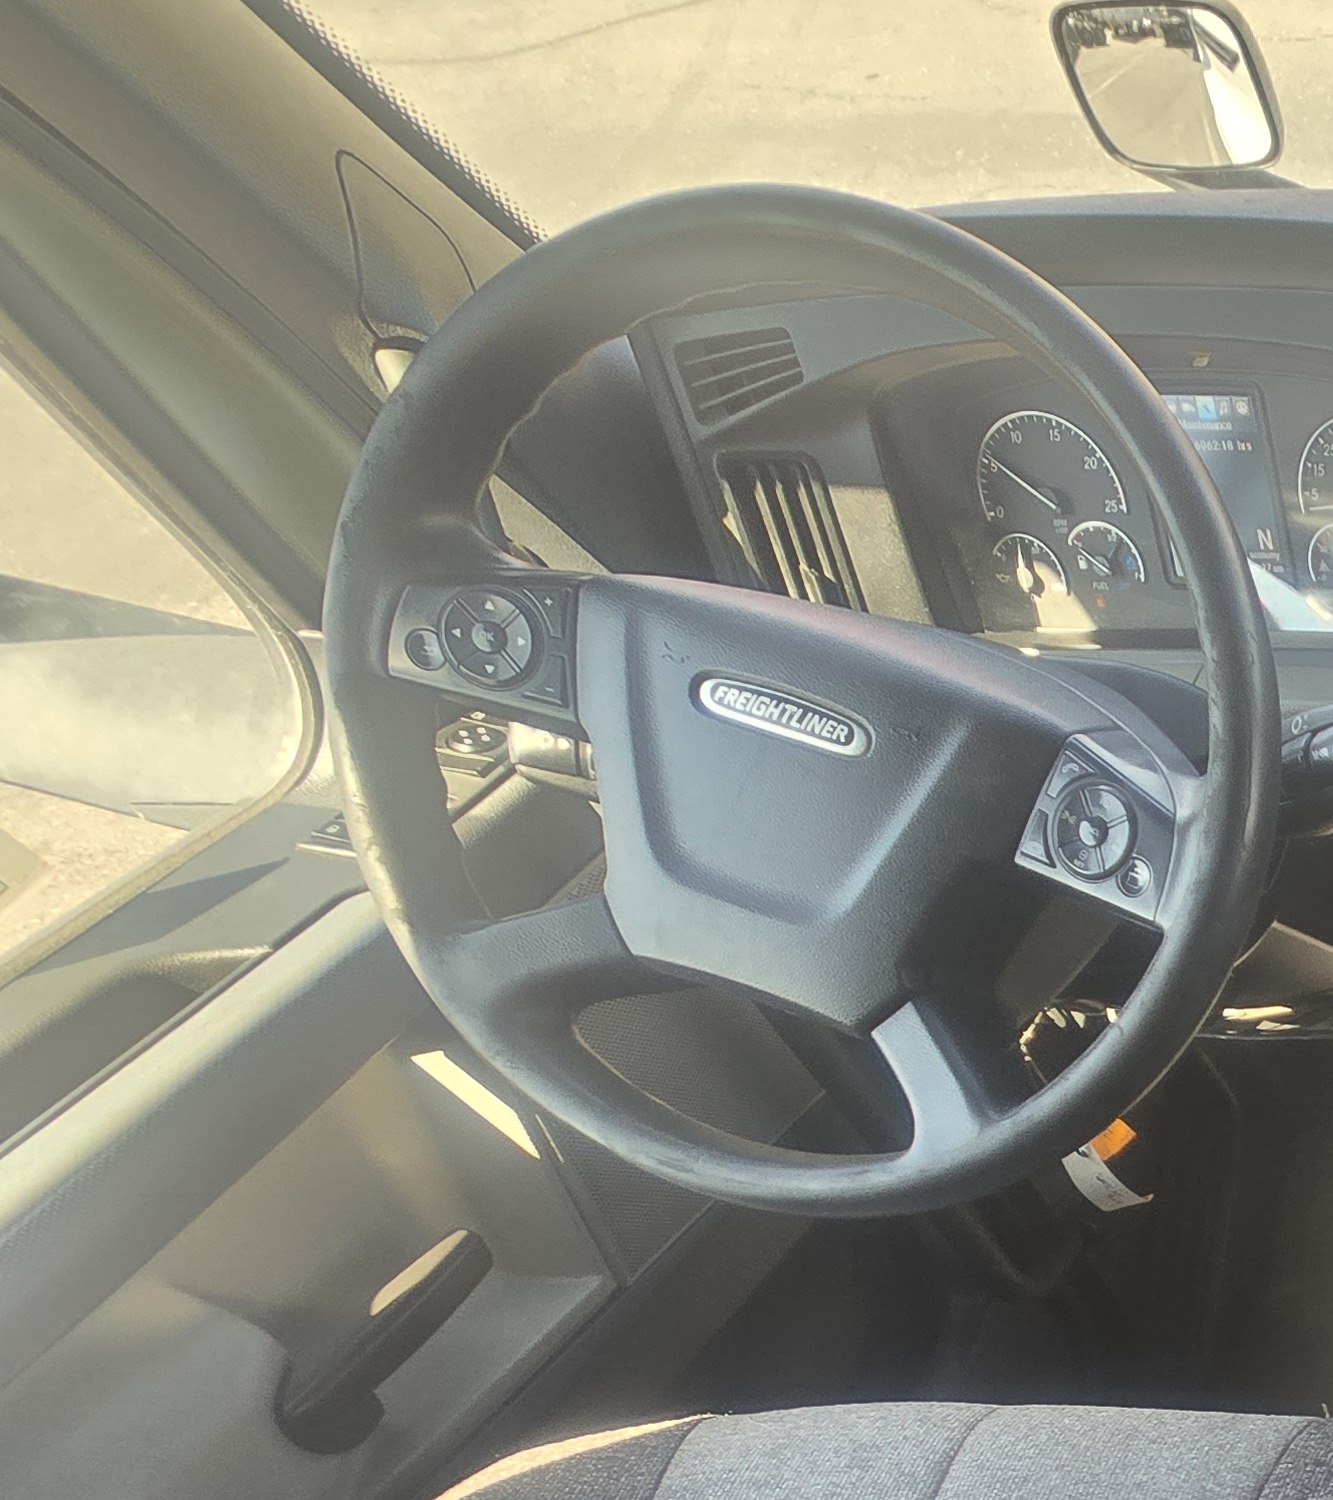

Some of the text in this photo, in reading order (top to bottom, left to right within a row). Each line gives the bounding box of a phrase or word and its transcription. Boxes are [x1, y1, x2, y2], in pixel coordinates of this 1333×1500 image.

[1010, 431, 1022, 444] 10
[1049, 429, 1061, 442] 15
[1083, 456, 1098, 470] 20
[1313, 463, 1325, 476] 15
[1311, 488, 1318, 500] 5
[996, 505, 1004, 518] 0
[1105, 500, 1118, 513] 25
[1257, 528, 1274, 550] N
[713, 685, 849, 743] FREIGHTLINER
